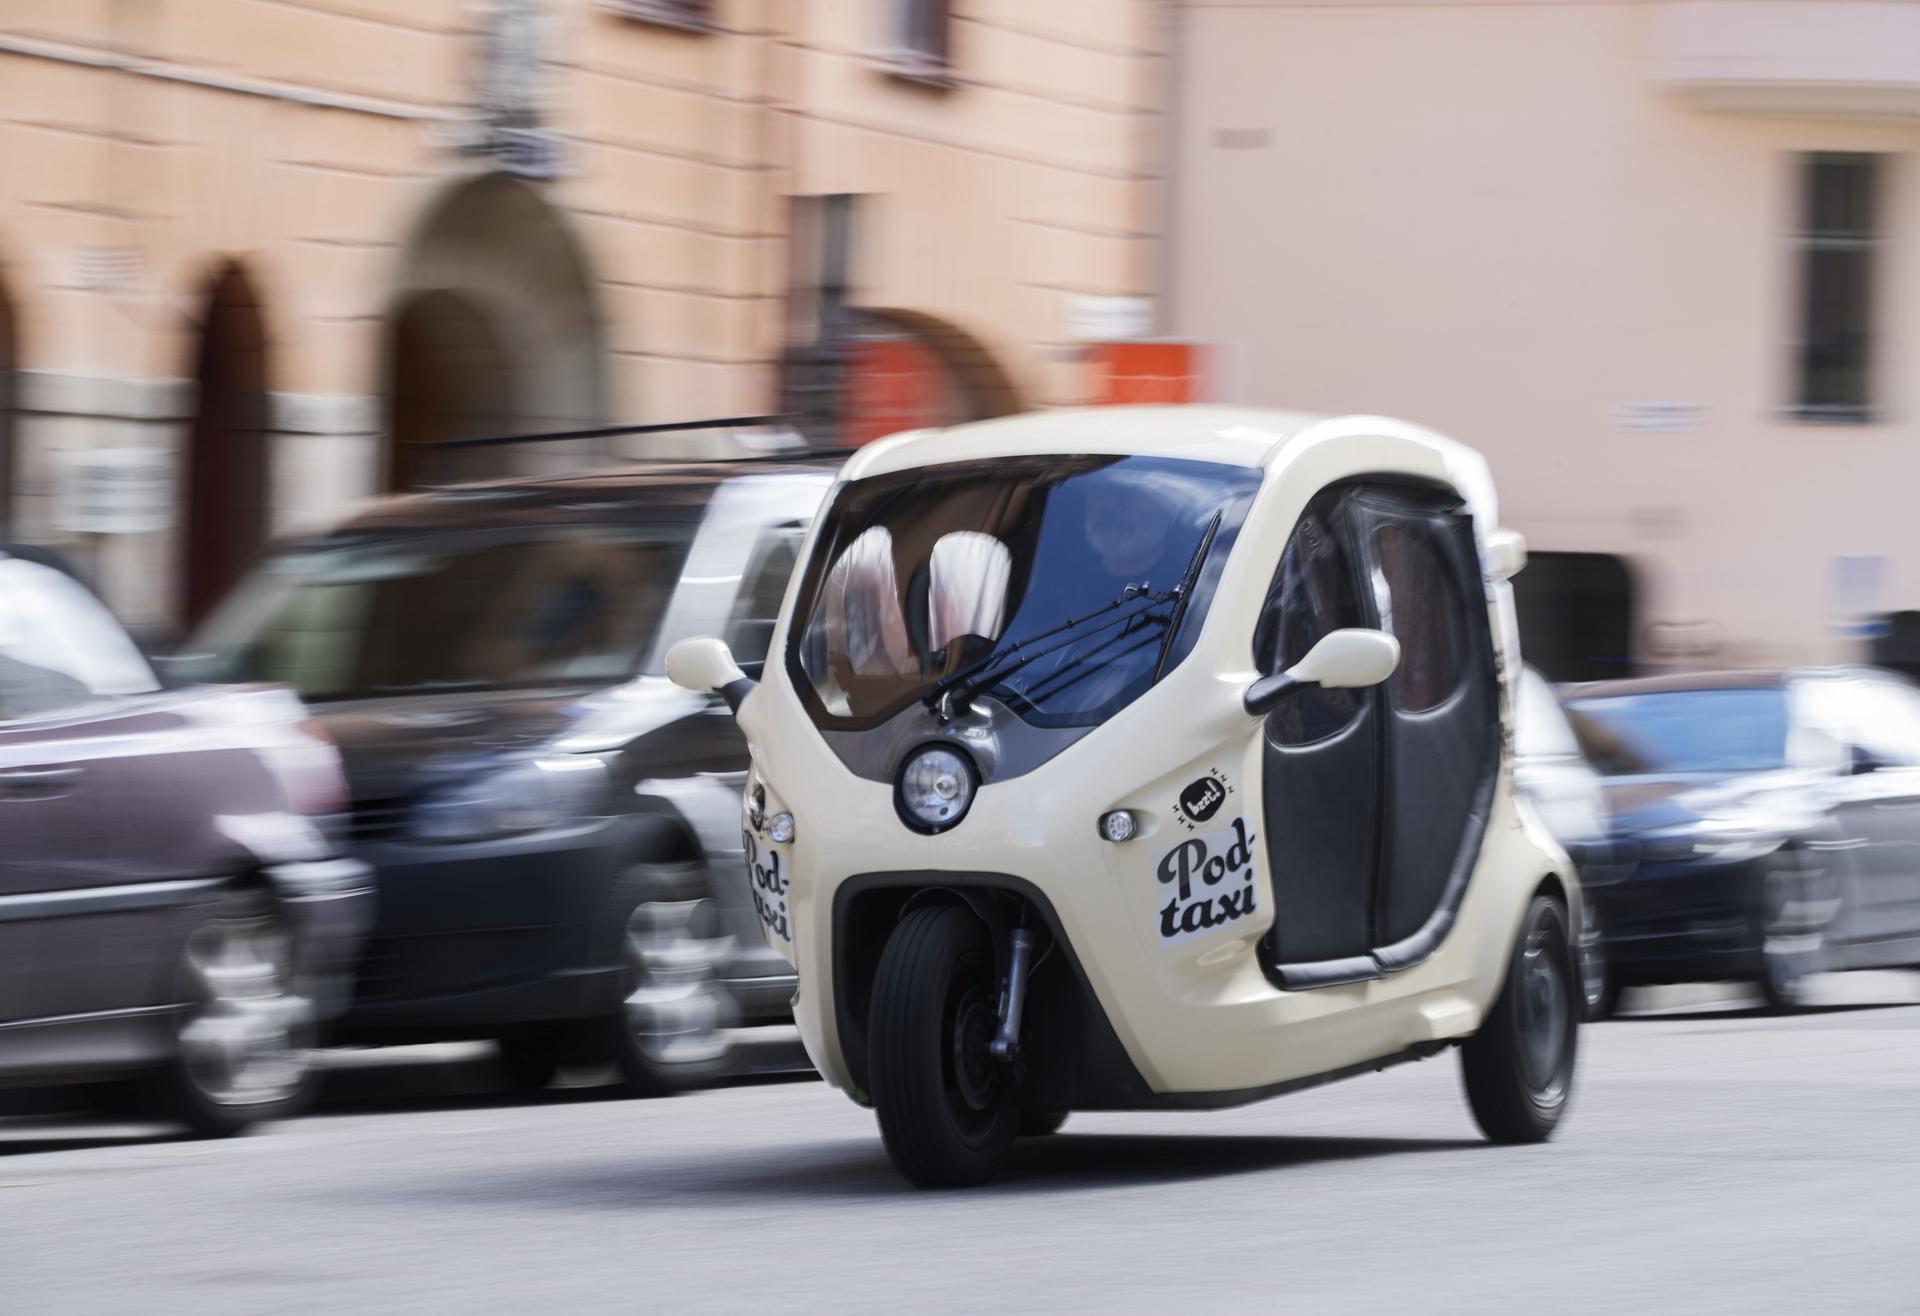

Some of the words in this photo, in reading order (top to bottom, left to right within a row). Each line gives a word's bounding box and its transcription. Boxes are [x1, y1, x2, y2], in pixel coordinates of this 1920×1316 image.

[1186, 780, 1221, 816] bzzt!
[1157, 817, 1256, 901] Pod-
[753, 888, 791, 942] axi
[1160, 868, 1256, 938] taxi
